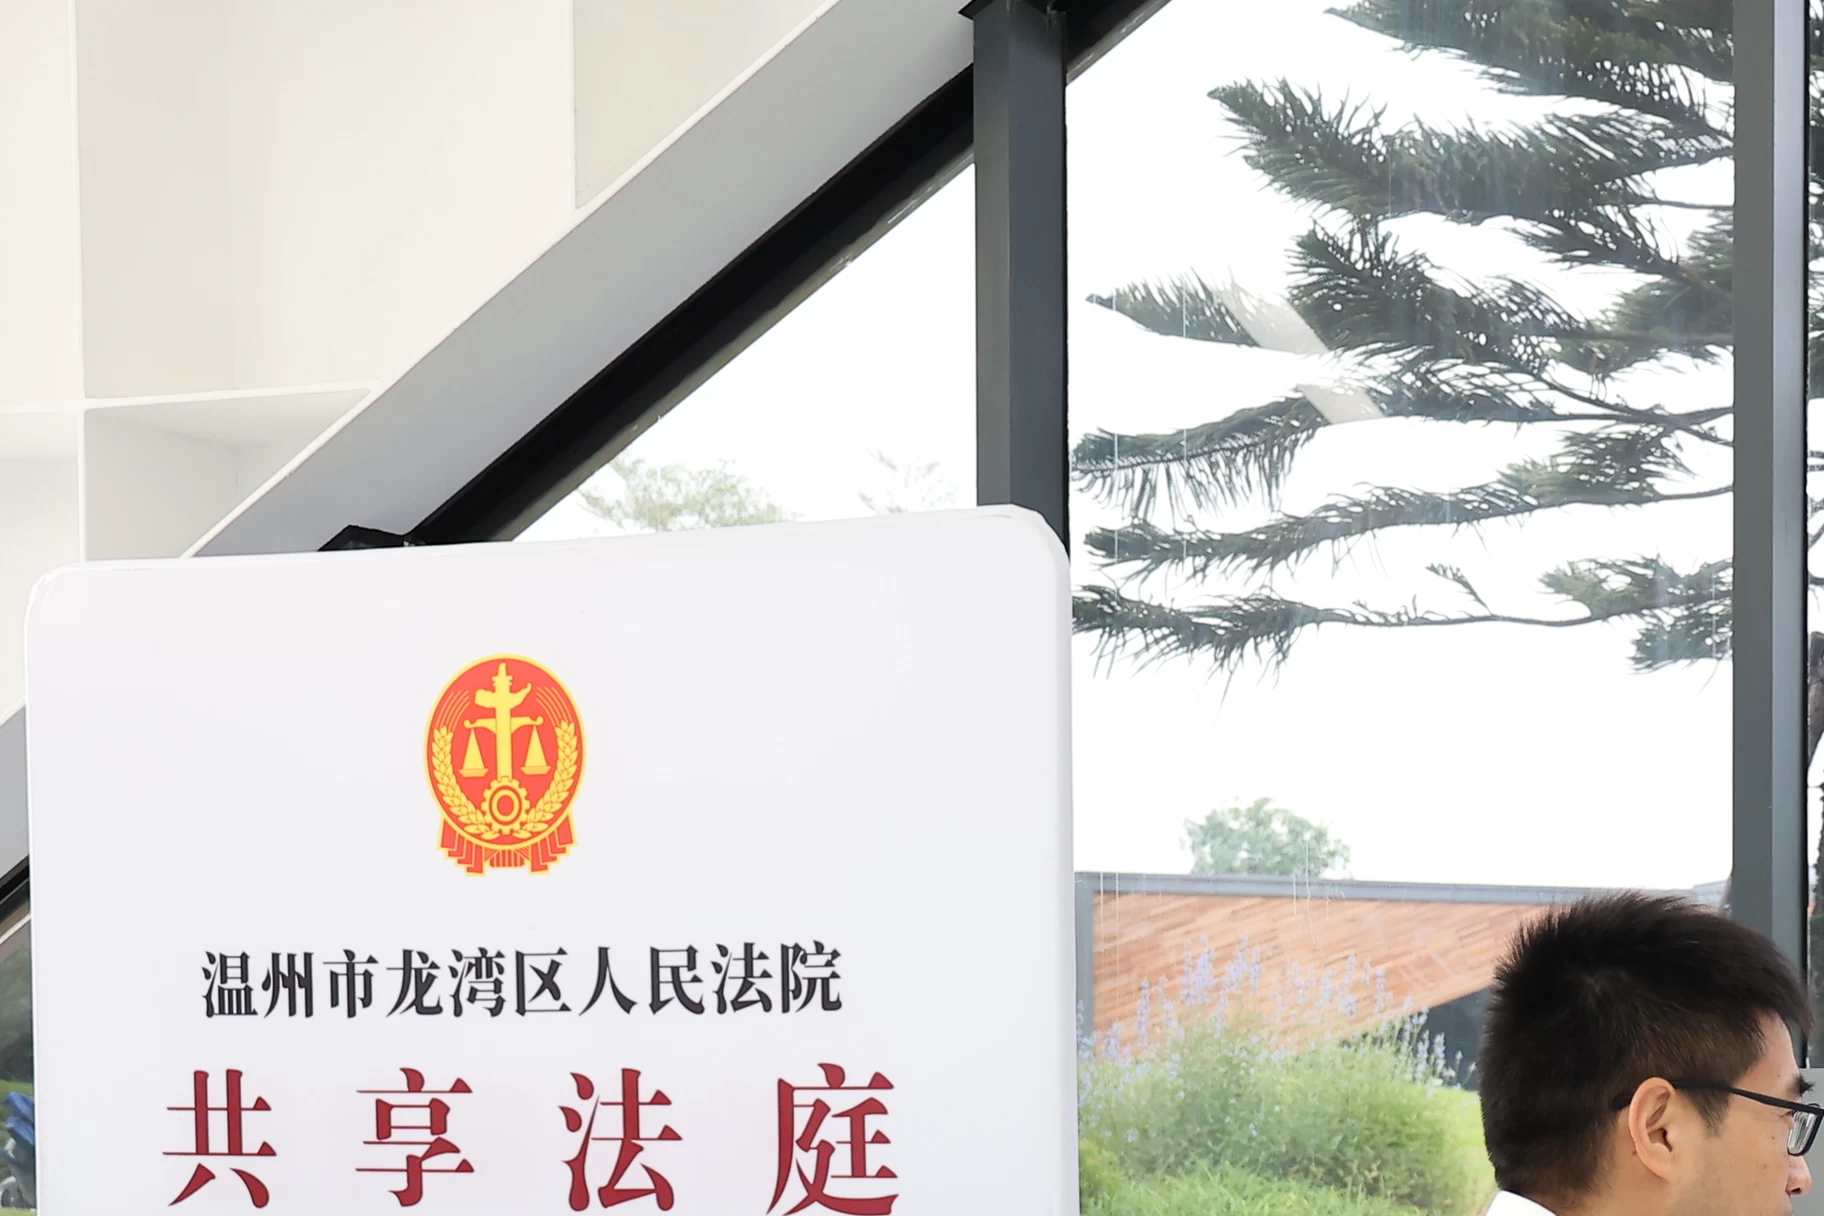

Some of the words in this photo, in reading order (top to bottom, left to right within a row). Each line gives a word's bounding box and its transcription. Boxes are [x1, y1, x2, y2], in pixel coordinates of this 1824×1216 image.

[200, 940, 843, 1019] 温州市龙湾区人民法院
[162, 1062, 899, 1216] 共享法庭
